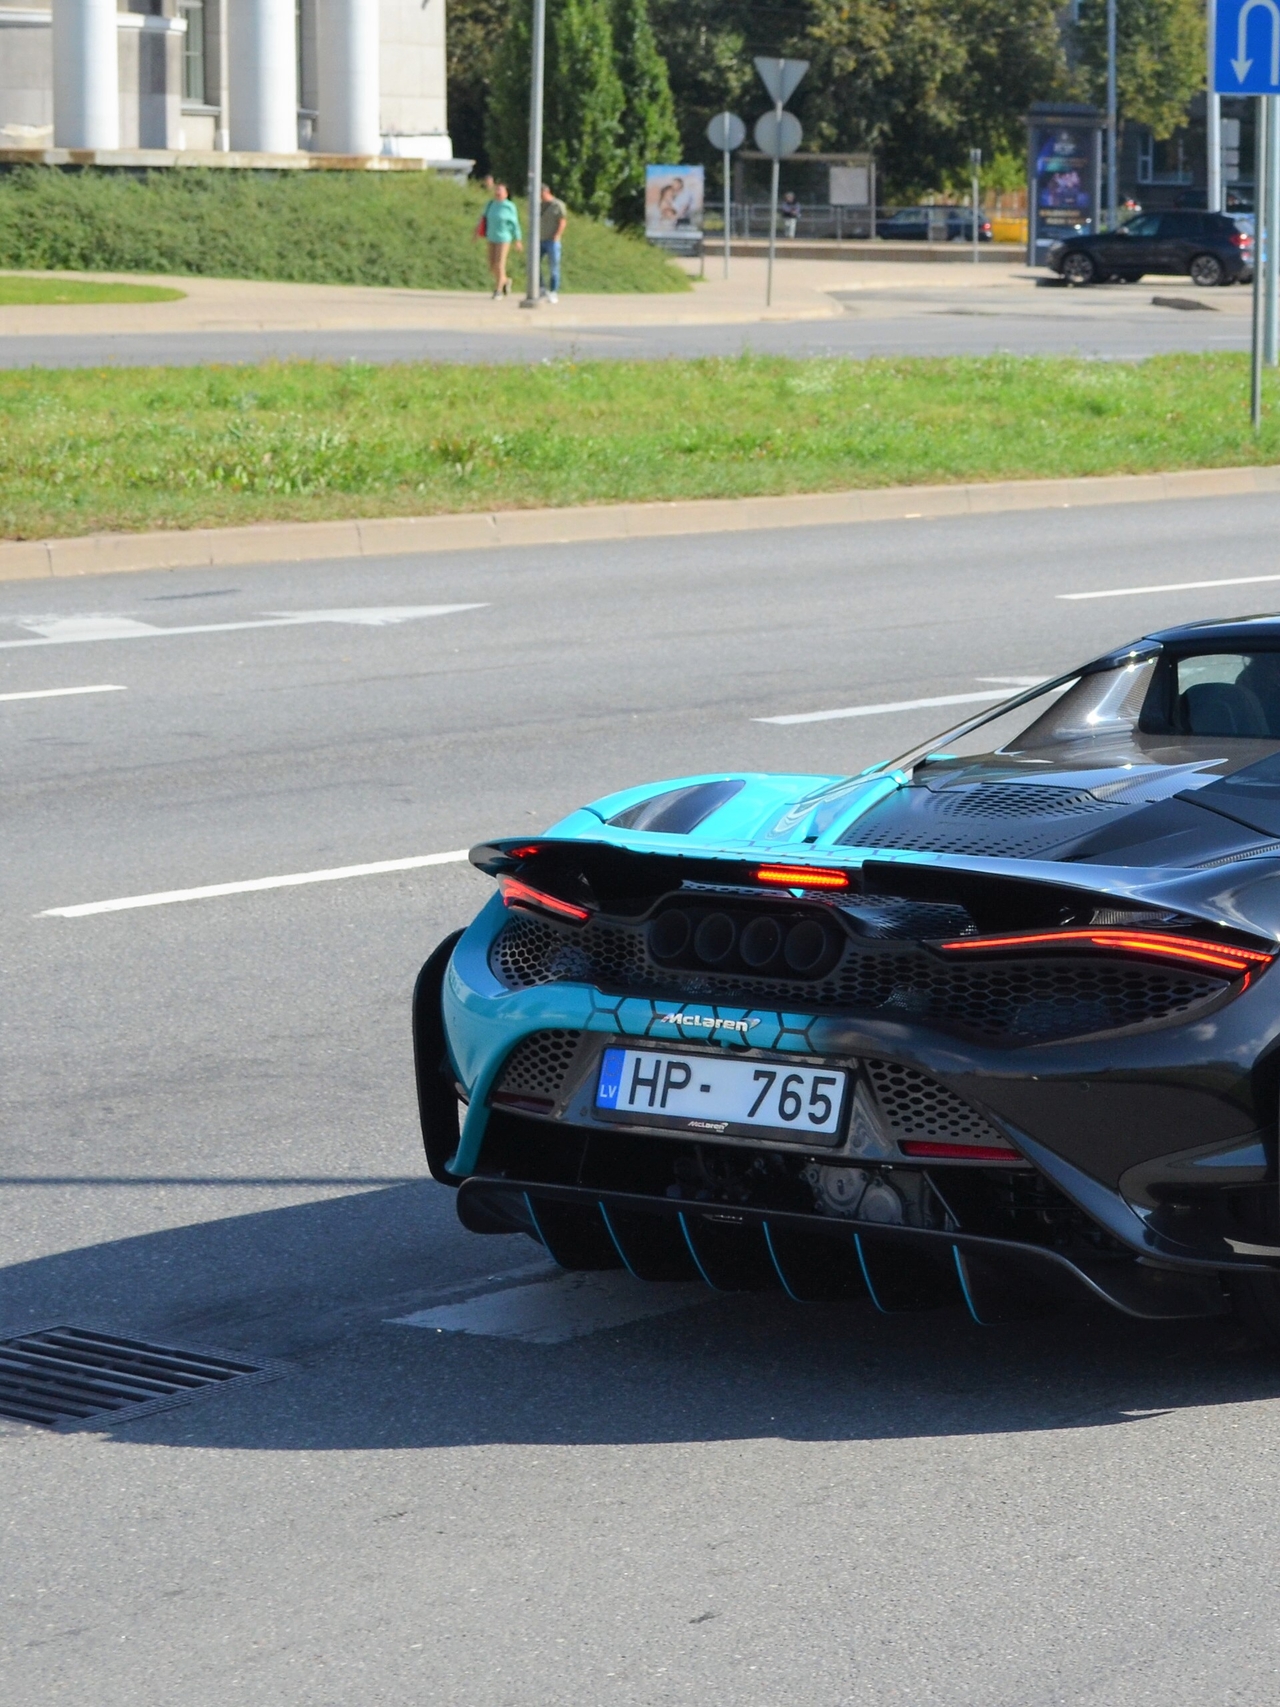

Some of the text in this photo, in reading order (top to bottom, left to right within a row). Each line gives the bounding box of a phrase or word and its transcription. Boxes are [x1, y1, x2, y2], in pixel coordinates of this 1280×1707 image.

[661, 1013, 748, 1031] McLaren
[600, 1085, 617, 1098] LV
[747, 1069, 837, 1125] 765
[688, 1120, 725, 1130] McLaren
